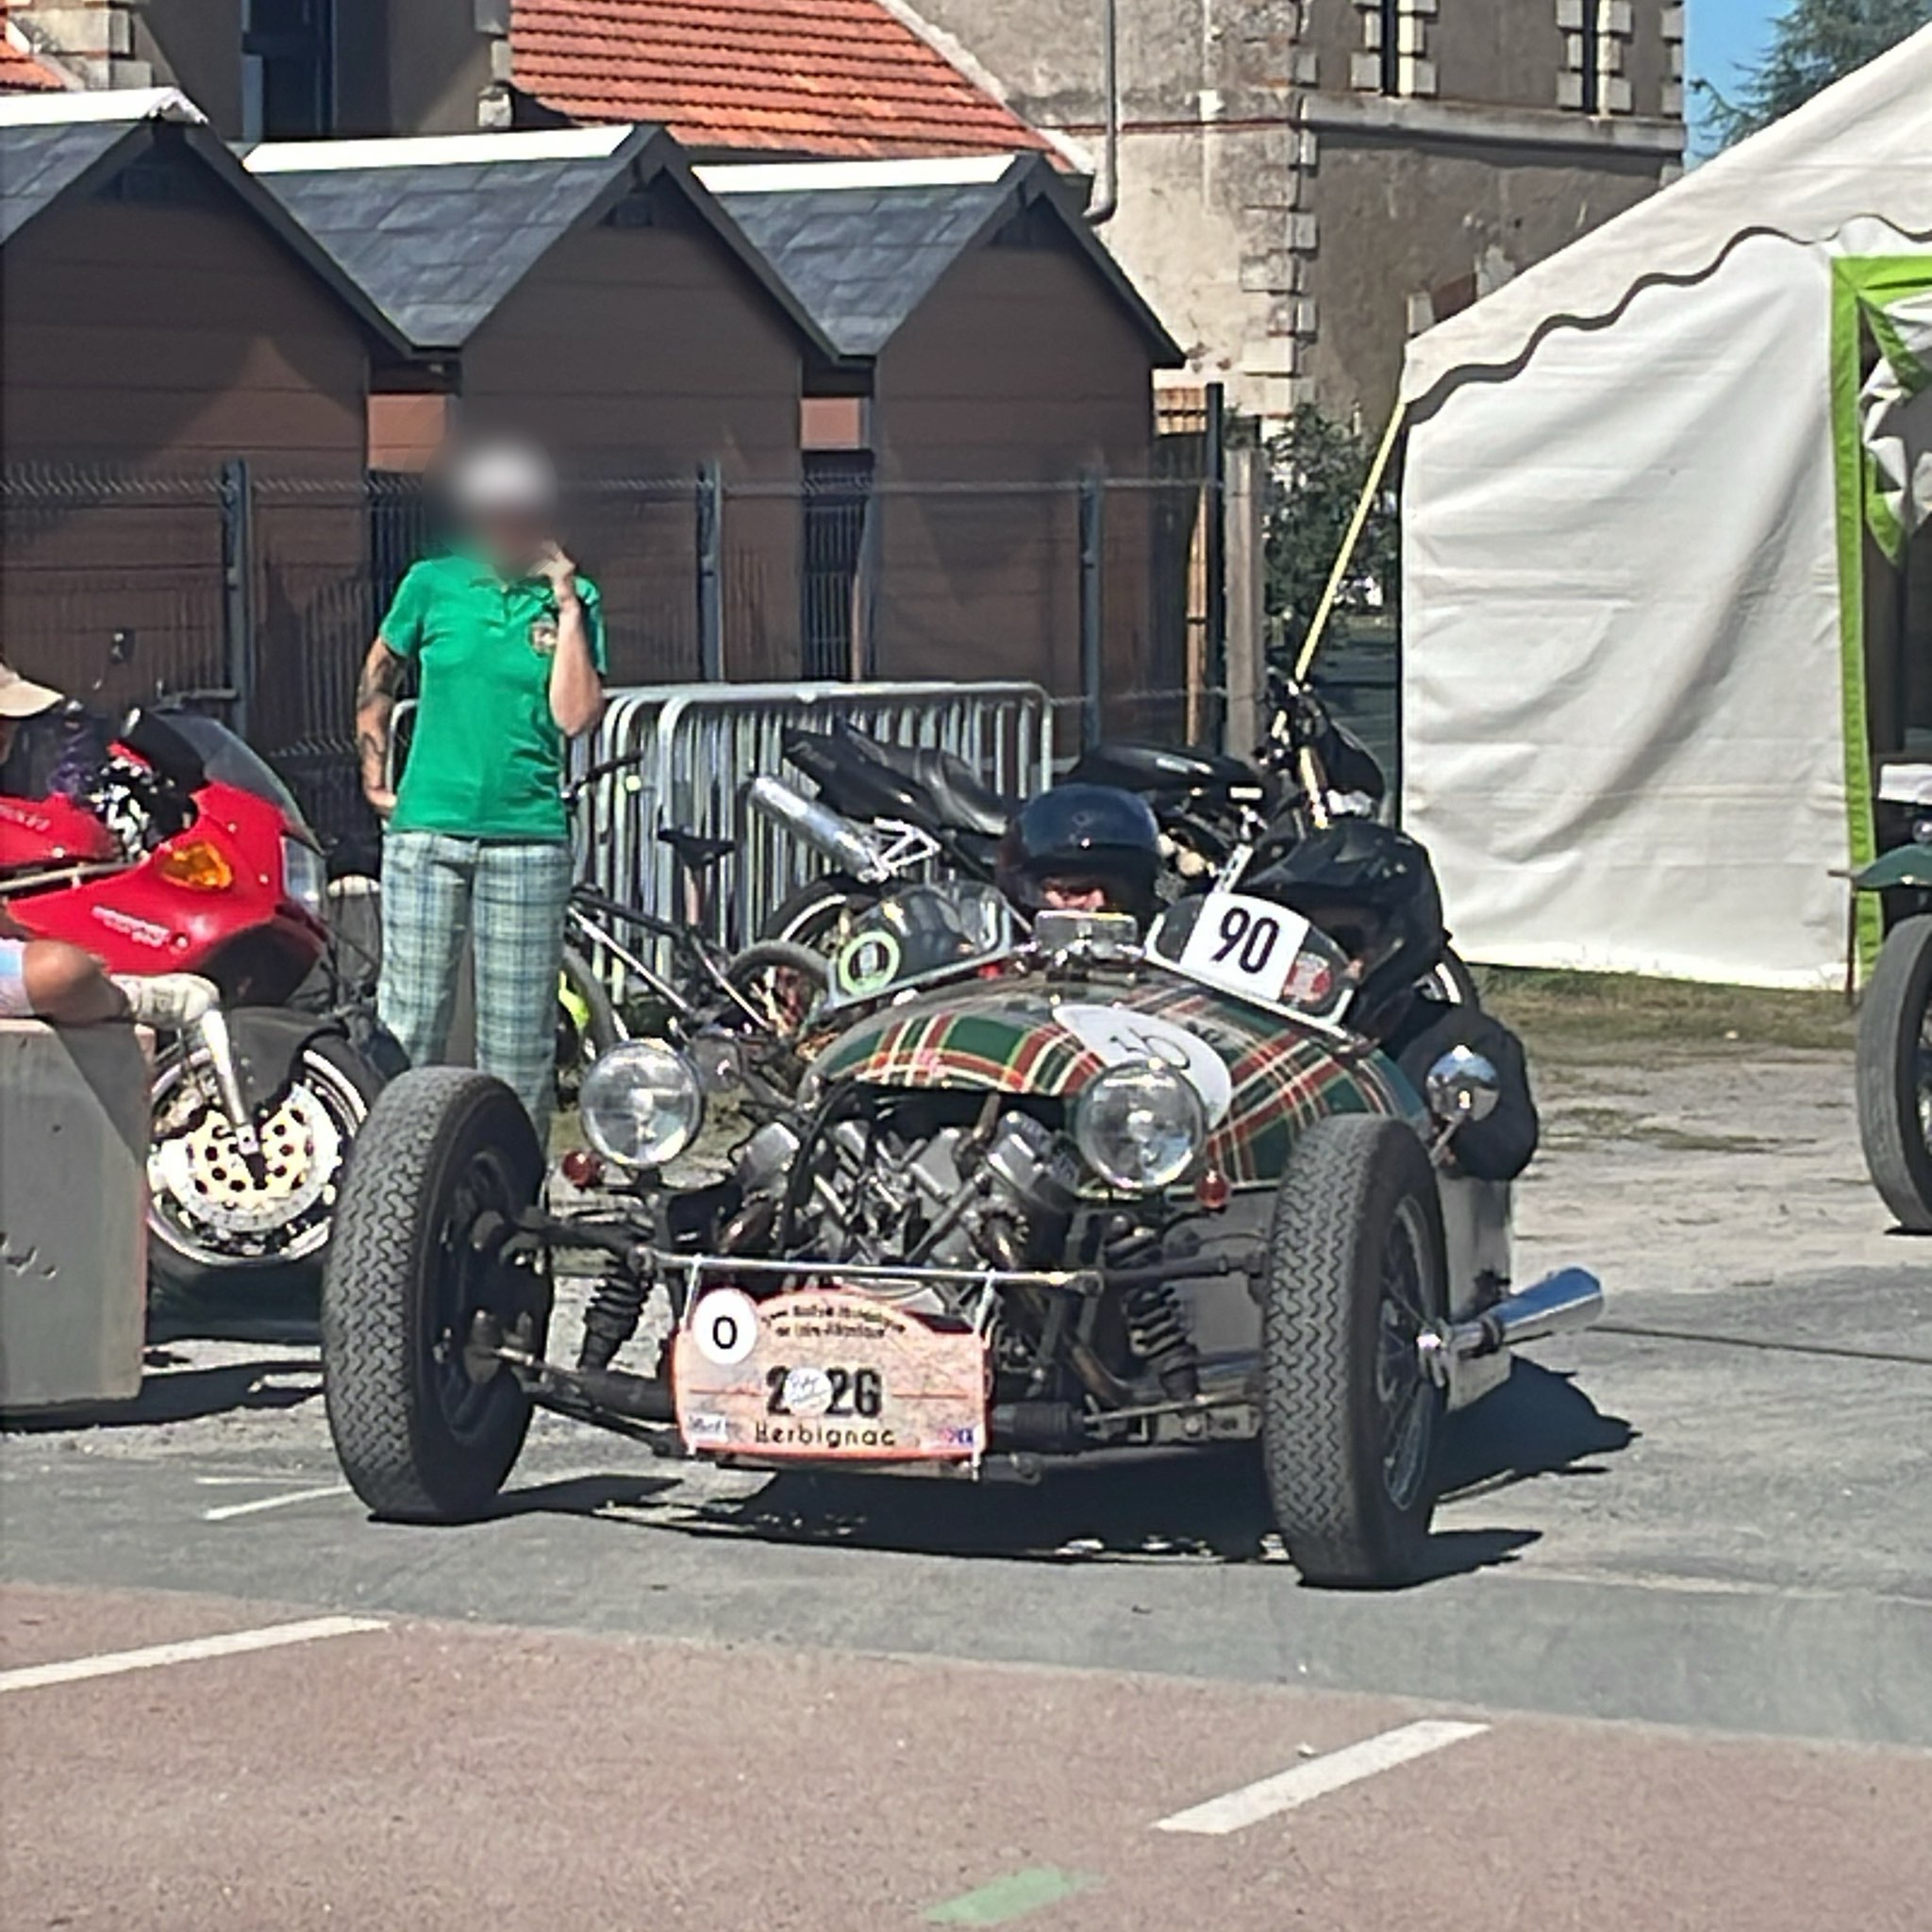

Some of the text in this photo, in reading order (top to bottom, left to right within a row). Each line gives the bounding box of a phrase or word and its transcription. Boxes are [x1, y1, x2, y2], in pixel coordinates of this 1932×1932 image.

[1211, 907, 1280, 974] 90
[766, 1365, 882, 1419] 226
[755, 1420, 896, 1448] Herbignac
